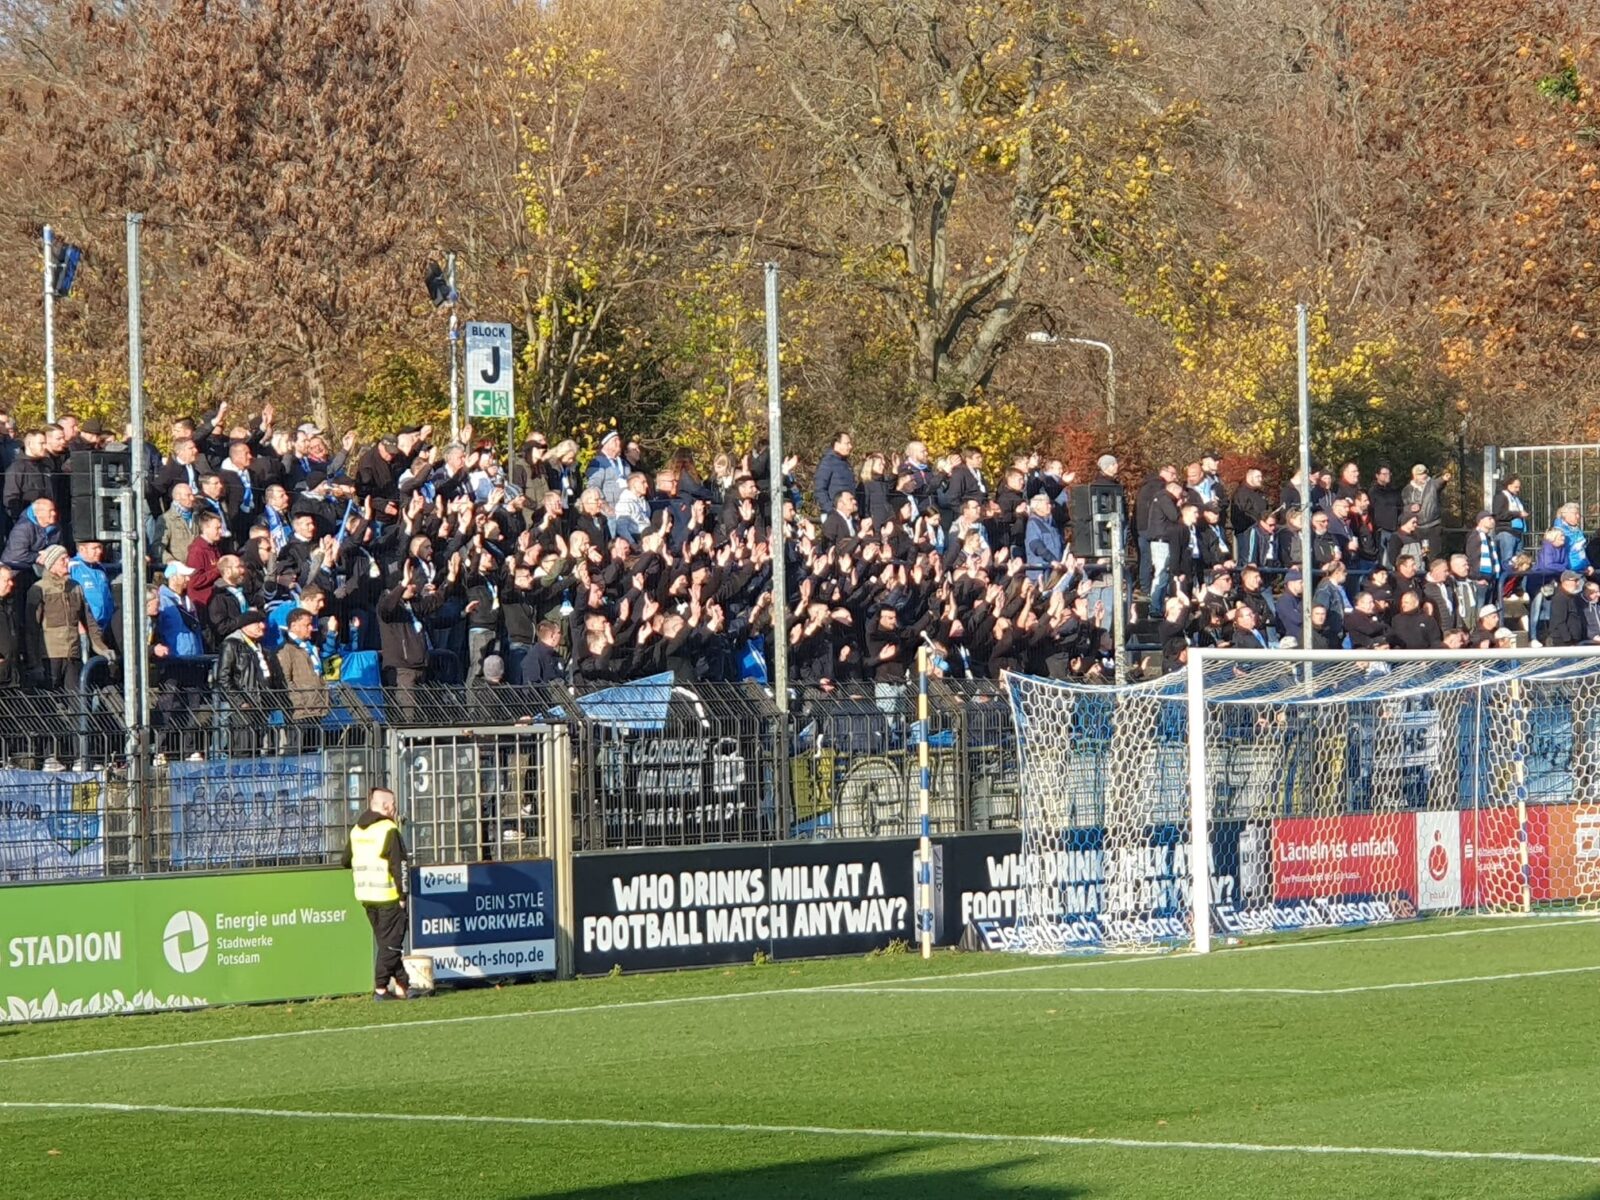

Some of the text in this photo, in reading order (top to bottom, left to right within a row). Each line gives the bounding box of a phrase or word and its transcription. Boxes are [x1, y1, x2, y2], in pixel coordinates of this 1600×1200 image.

[472, 326, 506, 337] BLOCK
[480, 346, 500, 384] J
[414, 756, 428, 792] 3
[1281, 839, 1328, 861] Lächeln
[1331, 840, 1347, 857] ist
[437, 872, 462, 886] PCH
[987, 853, 1041, 887] WHO
[613, 861, 884, 911] WHO DRINKS MILK AT A
[476, 891, 544, 911] DEIN STYLE
[962, 888, 1065, 925] FOOTBALL
[1216, 897, 1321, 931] Eisenbach
[216, 908, 347, 932] Energie und Wasser
[421, 911, 544, 935] DEINE WORKWEAR
[583, 897, 908, 952] FOOTBALL MATCH ANYWAY?
[978, 914, 1103, 950] Eisenbach
[9, 930, 121, 968] STADION
[216, 935, 274, 949] Stadtwerke
[217, 952, 261, 966] Potsdam
[432, 946, 544, 971] ww.pch-shop.de
